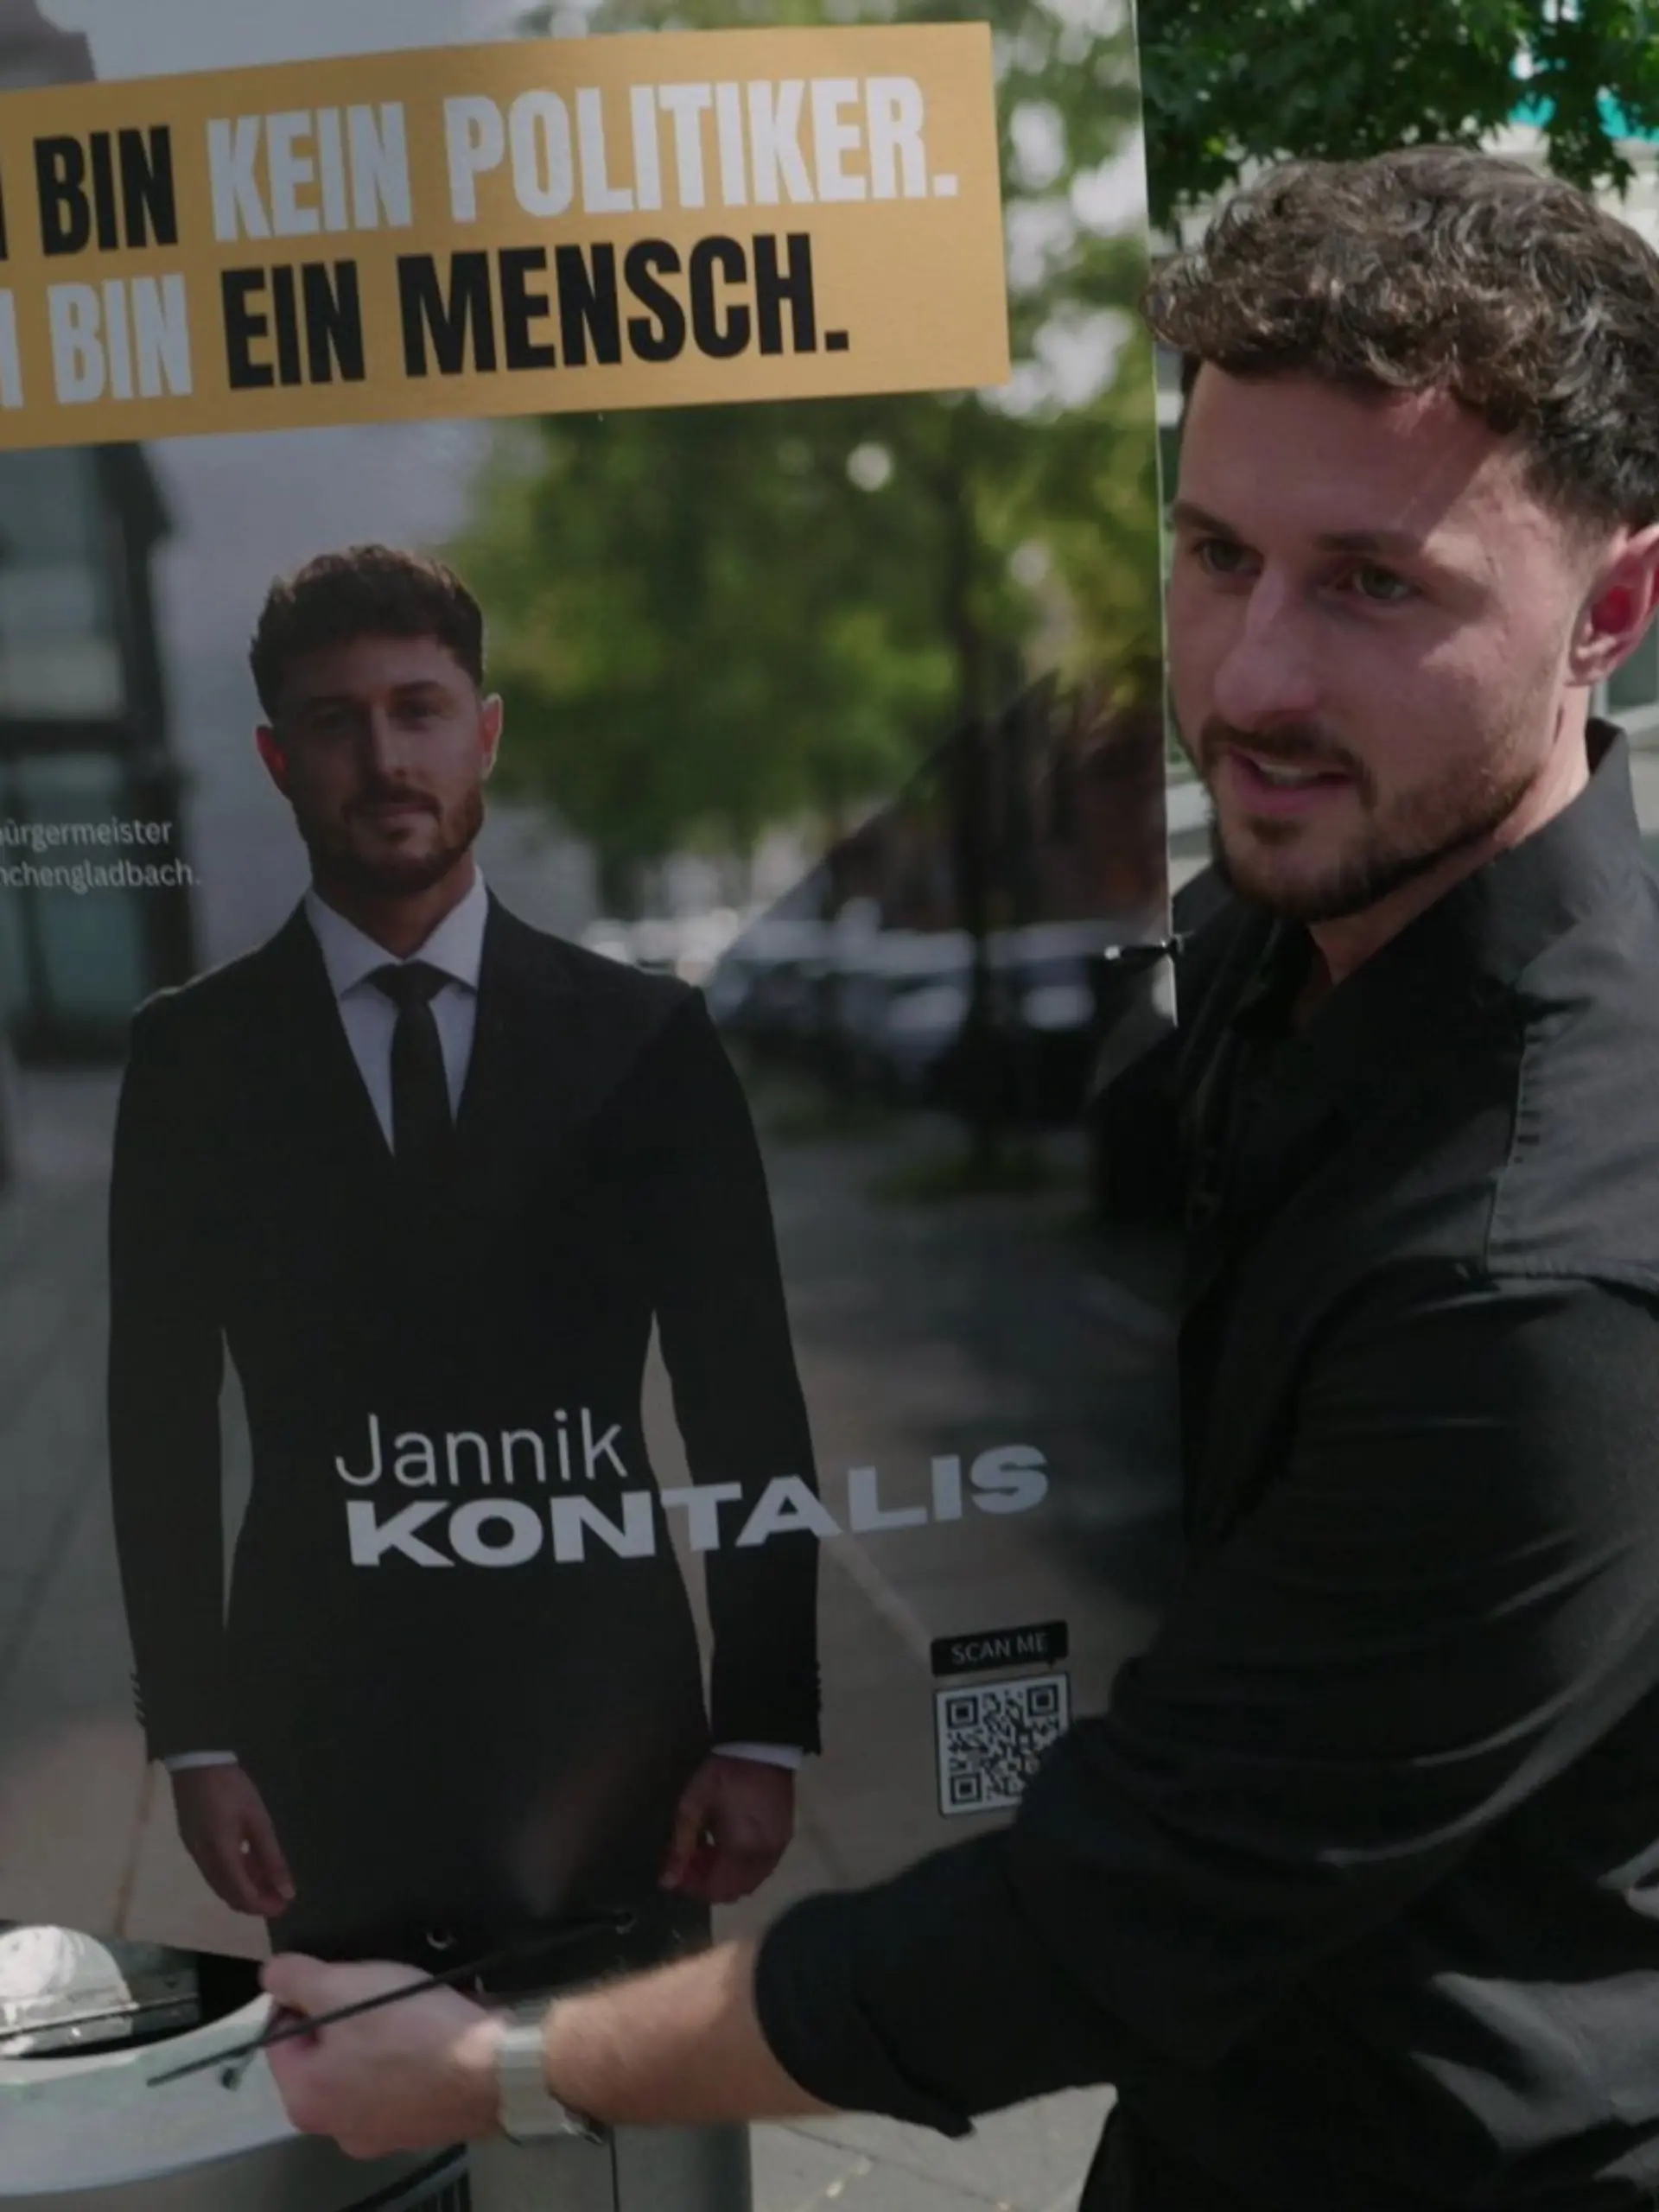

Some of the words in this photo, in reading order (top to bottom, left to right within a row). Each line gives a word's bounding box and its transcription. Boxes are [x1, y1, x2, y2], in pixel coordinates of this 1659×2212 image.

[34, 125, 178, 257] BIN
[206, 101, 413, 242] KEIN
[442, 77, 958, 223] POLITIKER.
[47, 272, 193, 405] BIN
[221, 260, 366, 390] EIN
[397, 232, 849, 378] MENSCH.
[334, 1408, 628, 1487] Jannik
[346, 1445, 1049, 1567] KONTALIS
[951, 1639, 1012, 1665] SCAN
[1016, 1632, 1048, 1654] ME
